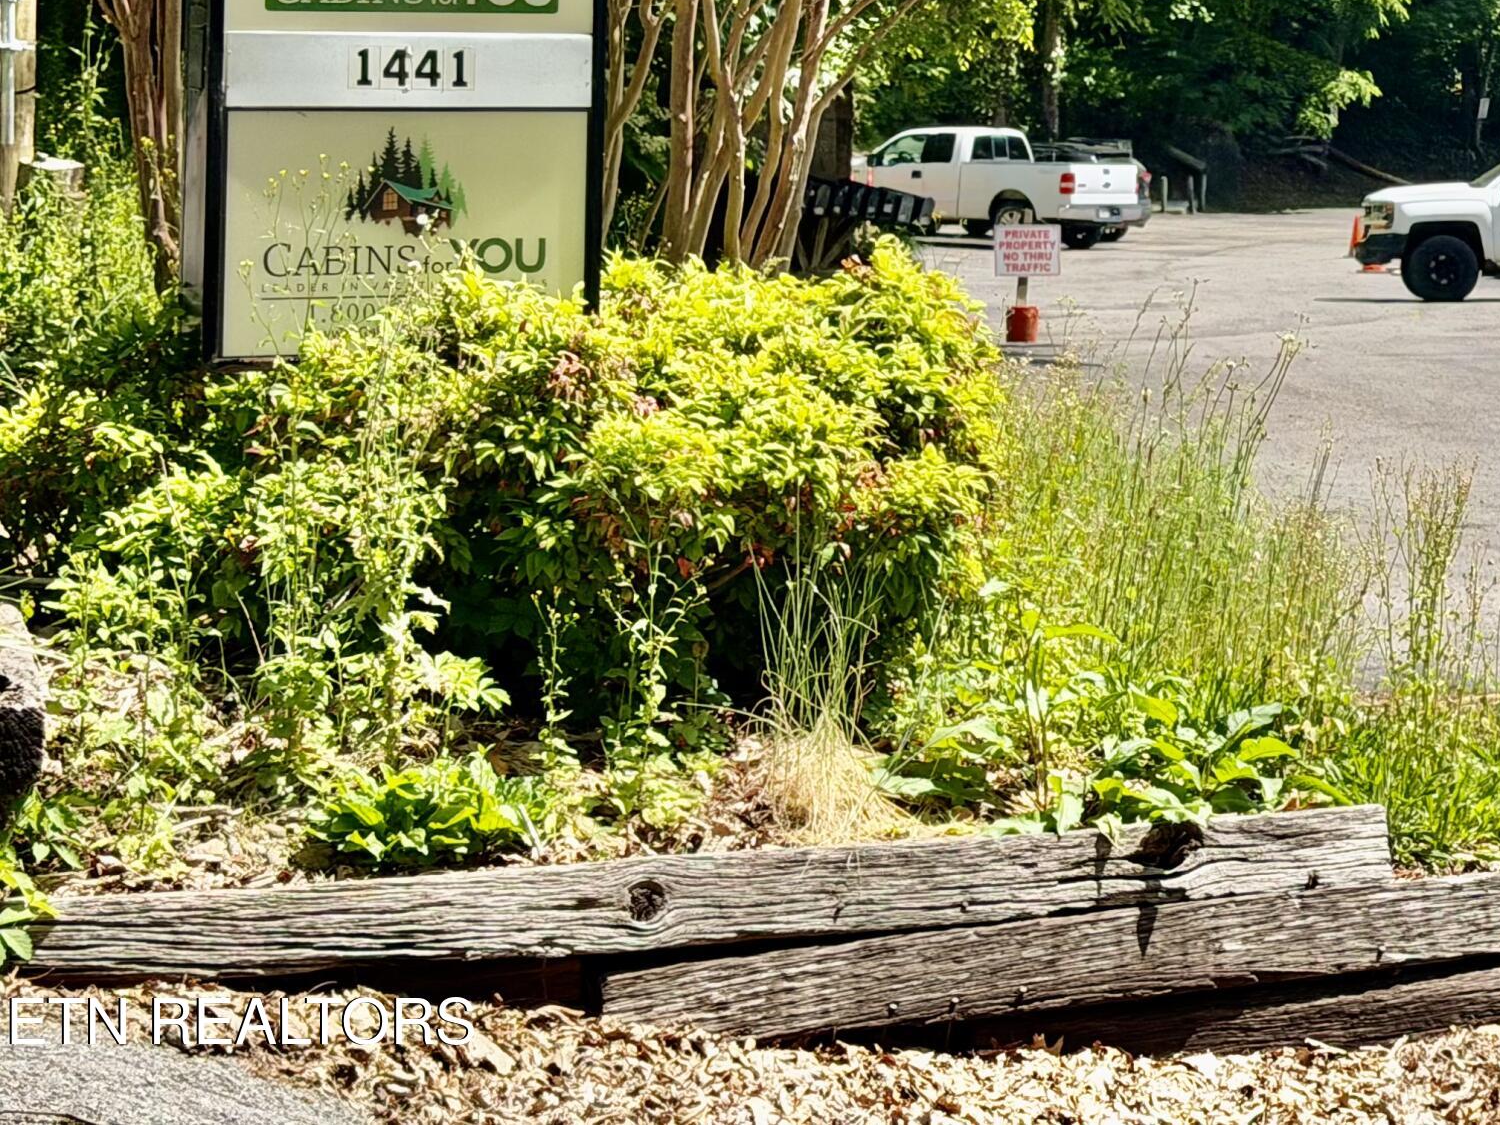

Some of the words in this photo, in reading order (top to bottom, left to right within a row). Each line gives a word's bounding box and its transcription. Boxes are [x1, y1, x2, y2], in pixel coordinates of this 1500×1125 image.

[355, 48, 468, 87] 1441
[1004, 229, 1050, 240] PRIVATE
[999, 241, 1056, 251] PROPERTY
[263, 242, 416, 278] CABINS
[422, 255, 453, 274] for
[1003, 251, 1020, 262] NO
[1023, 251, 1053, 262] THRU
[1004, 262, 1051, 273] TRAFFIC
